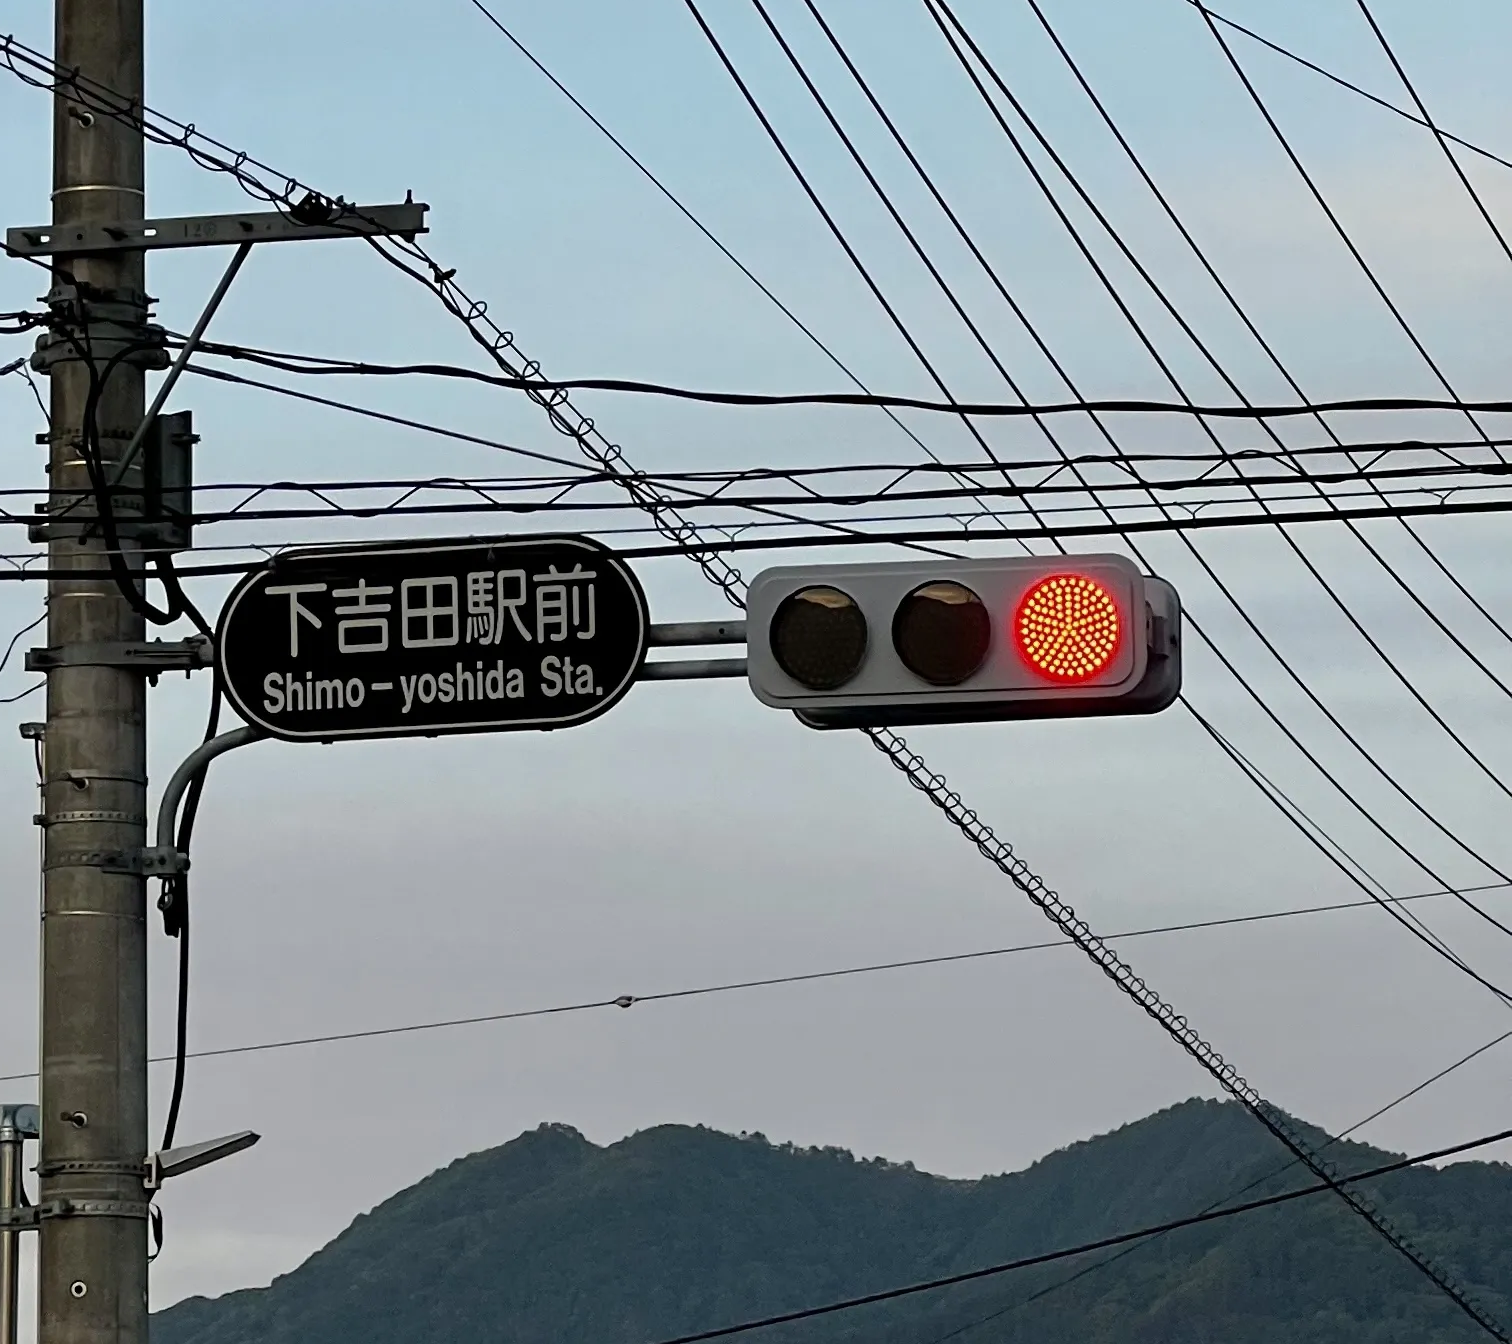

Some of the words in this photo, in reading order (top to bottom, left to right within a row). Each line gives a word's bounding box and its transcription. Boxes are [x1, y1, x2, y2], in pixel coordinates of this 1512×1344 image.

[264, 563, 597, 658] 下吉田駅前
[541, 656, 603, 698] Sta.
